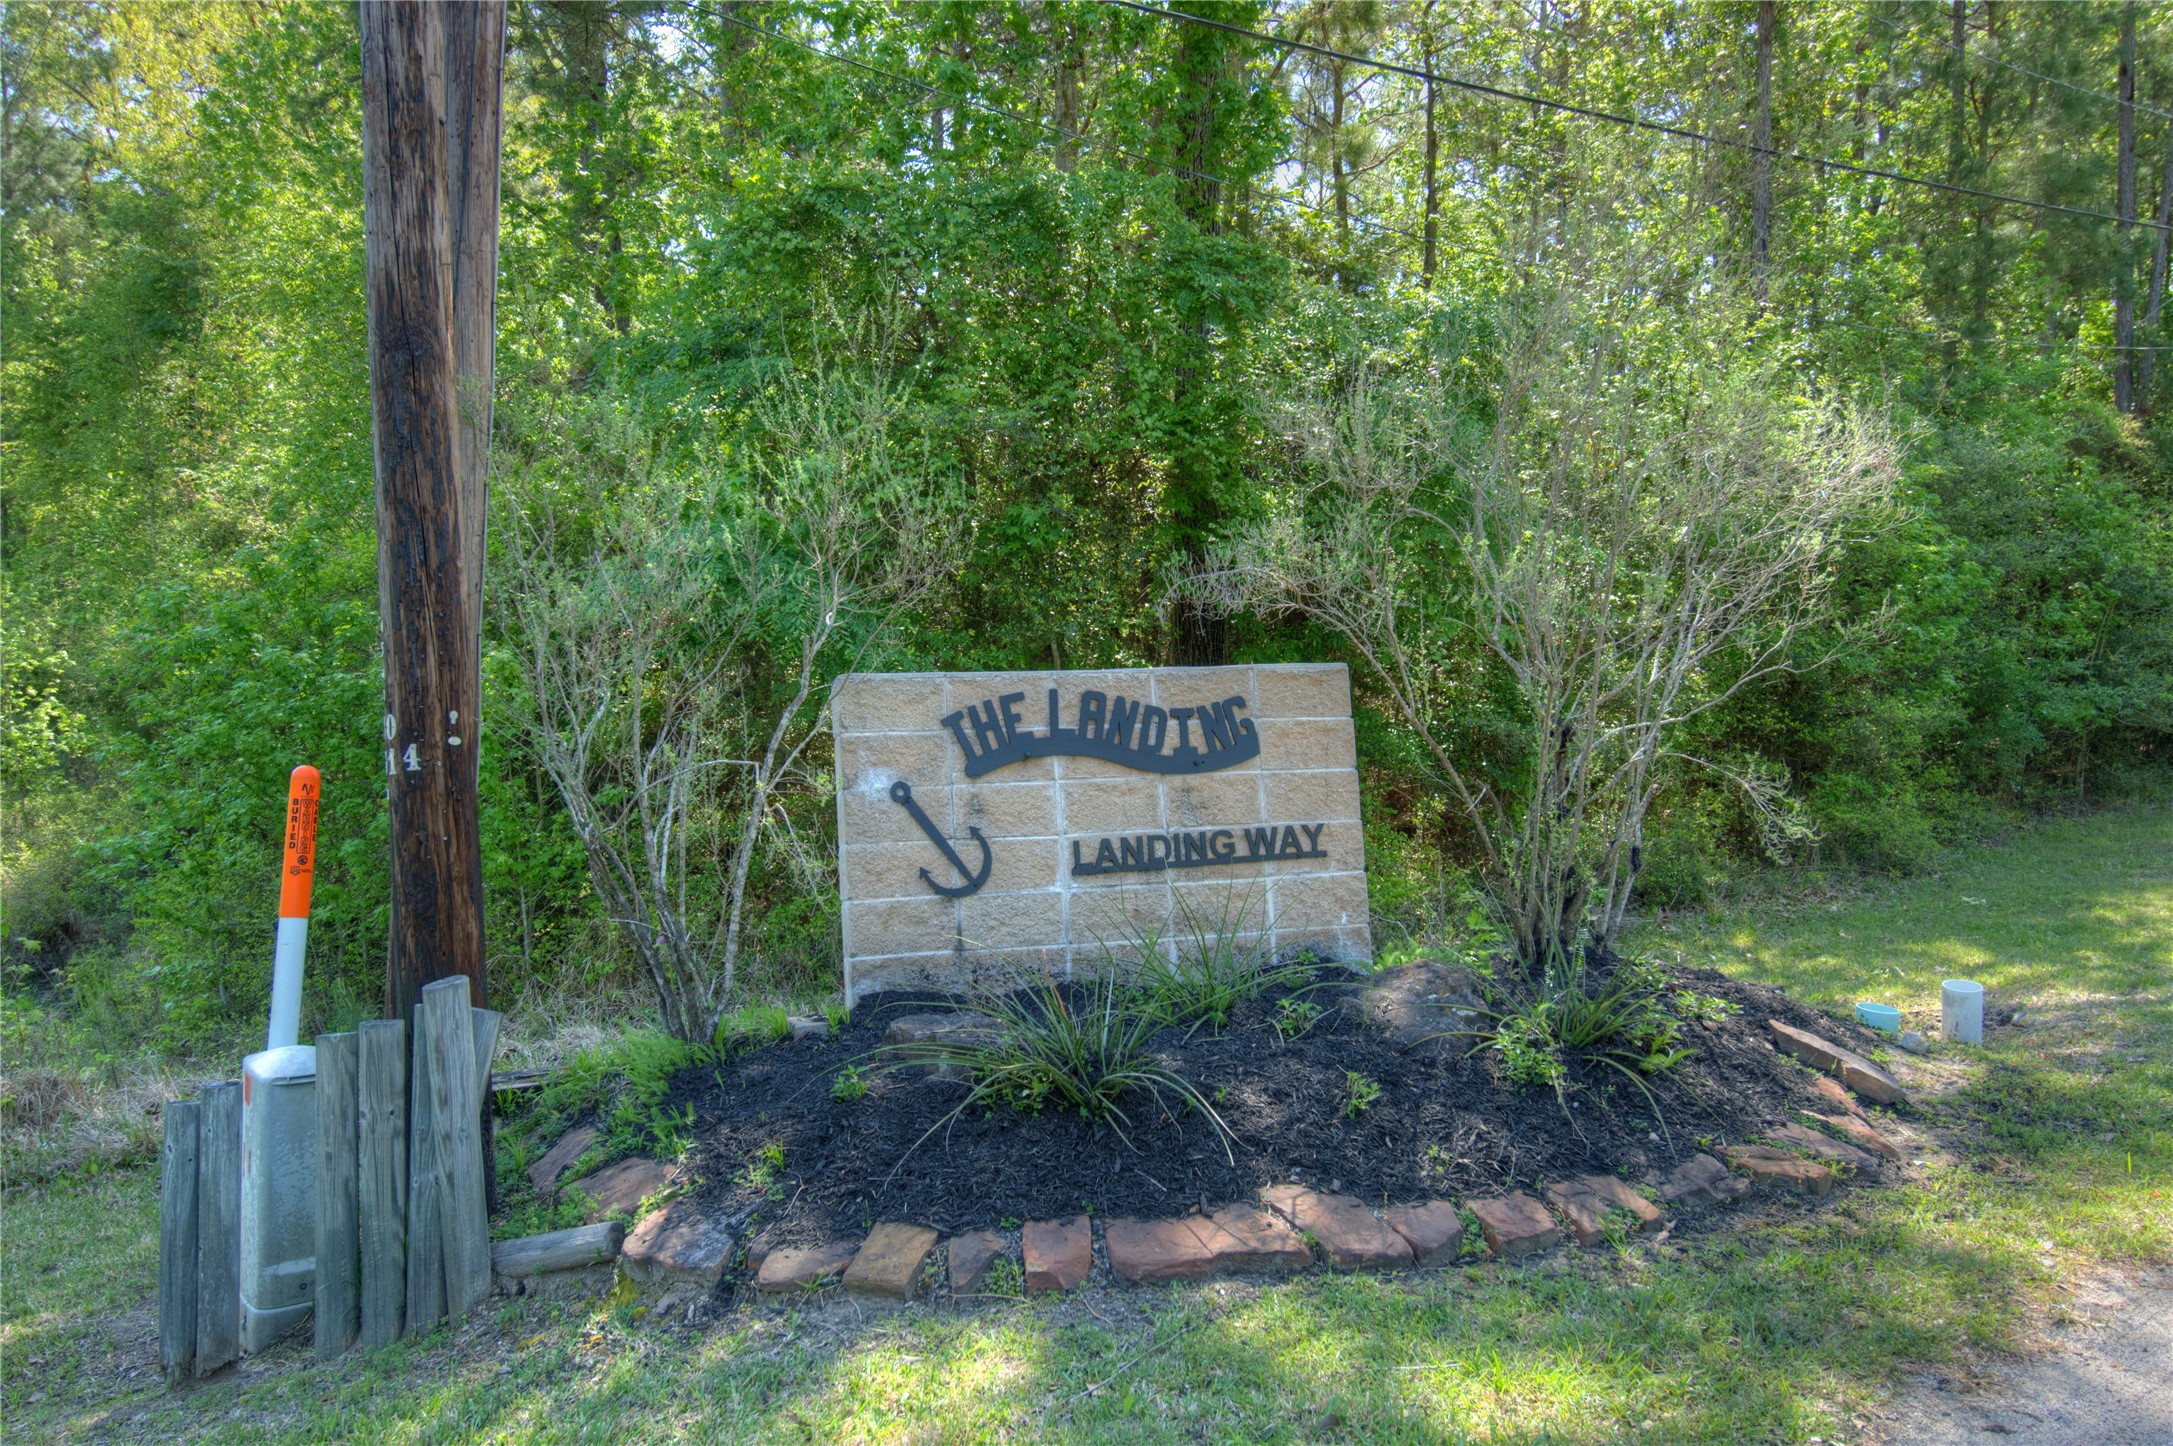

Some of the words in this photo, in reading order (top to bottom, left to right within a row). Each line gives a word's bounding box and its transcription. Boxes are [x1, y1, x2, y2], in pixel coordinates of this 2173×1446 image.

[941, 692, 1034, 760] THE
[1048, 688, 1258, 758] LANDING
[289, 798, 299, 849] BURIED
[312, 799, 320, 842] CABLE
[1073, 829, 1236, 870] LANDING
[1244, 823, 1325, 857] WAY
